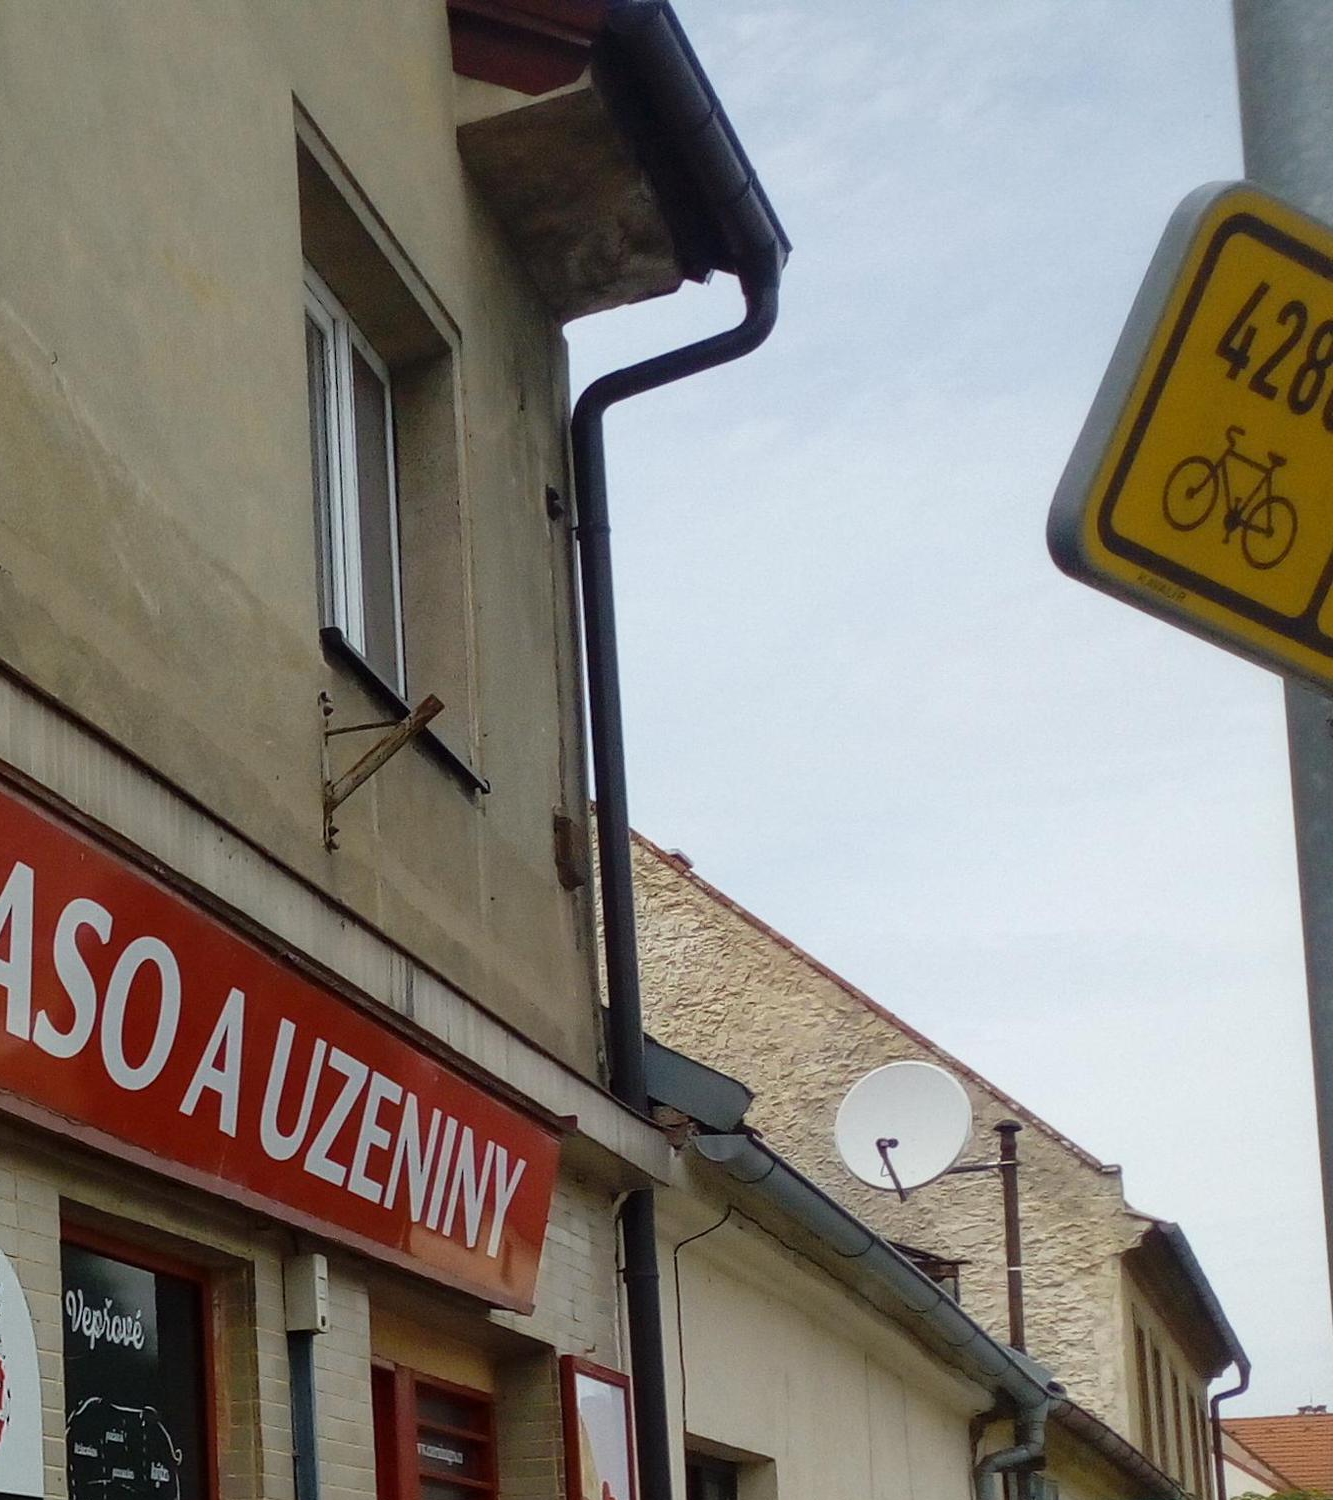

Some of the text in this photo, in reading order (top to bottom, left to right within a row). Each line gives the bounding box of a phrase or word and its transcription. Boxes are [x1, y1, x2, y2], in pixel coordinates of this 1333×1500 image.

[178, 986, 246, 1138] A
[259, 1017, 526, 1260] UZENINY
[64, 1288, 146, 1352] Vepřové
